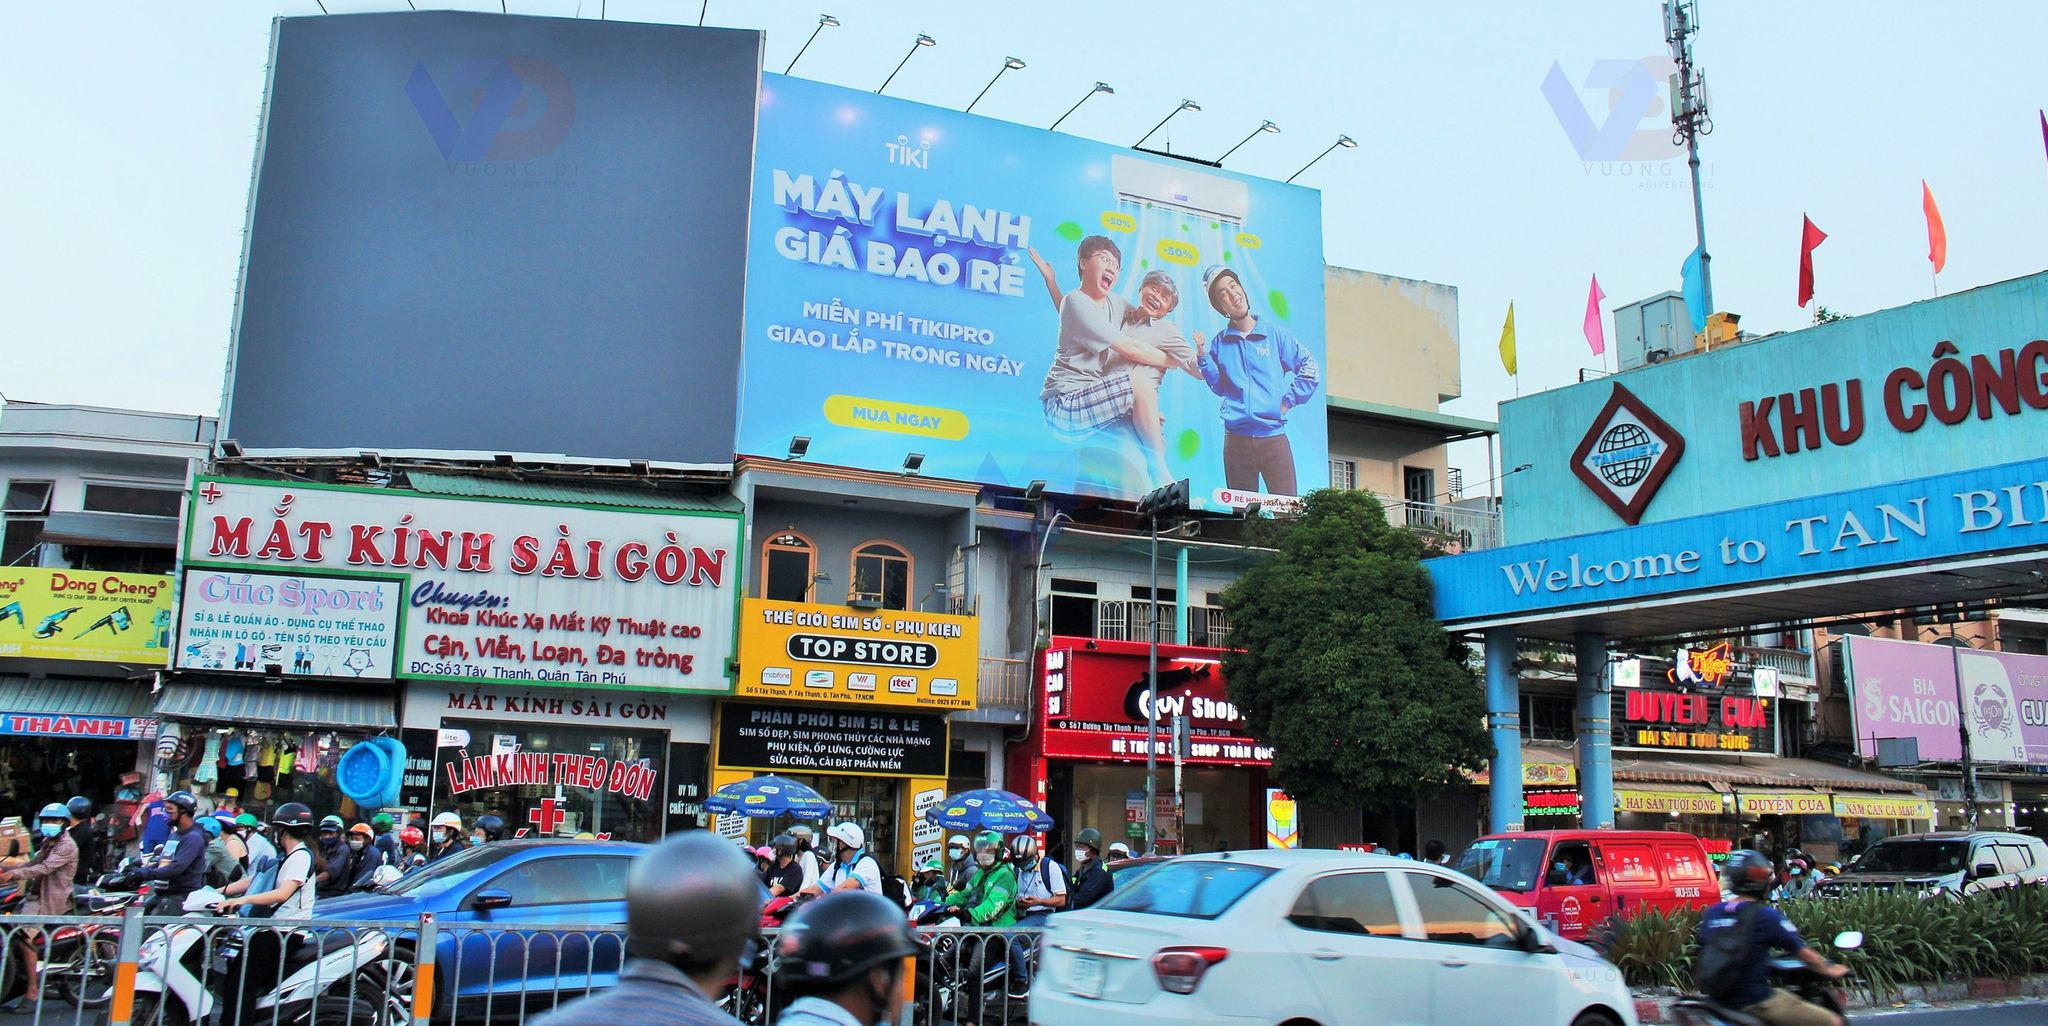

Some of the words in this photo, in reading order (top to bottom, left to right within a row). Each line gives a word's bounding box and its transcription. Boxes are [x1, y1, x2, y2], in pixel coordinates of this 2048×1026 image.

[772, 168, 884, 227] MÁY
[896, 192, 1031, 250] LẠNH
[774, 225, 860, 272] GIÁ
[866, 240, 961, 286] BAO
[965, 252, 1026, 297] RẺ
[1163, 246, 1194, 260] -50%
[802, 298, 861, 327] MIỄN
[866, 310, 904, 333] PHÍ
[908, 316, 995, 346] TIKIPRO
[766, 324, 826, 349] GIAO
[832, 328, 877, 354] LẮP
[882, 341, 961, 368] TRONG
[966, 349, 1025, 377] NGÀY
[1739, 377, 1865, 462] KHU
[1883, 340, 2048, 433] CÔNG
[852, 405, 890, 425] MUA
[895, 412, 943, 430] NGAY
[1591, 442, 1660, 467] TANIMEX
[208, 494, 333, 562] MẮT
[347, 512, 496, 573] KÍNH
[509, 523, 604, 580] SÀI
[614, 530, 727, 588] GÒN
[1500, 549, 1700, 597] Welcome
[1719, 535, 1767, 566] to
[1785, 496, 1929, 557] TAN
[51, 573, 97, 594] Dong
[102, 576, 158, 598] Cheng
[199, 575, 274, 605] Cúc
[278, 579, 384, 615] Sport
[411, 580, 510, 612] Chuyên:
[207, 614, 214, 622] &
[287, 617, 315, 630] DỤNG
[318, 619, 332, 631] CỤ
[358, 621, 385, 632] THAO
[426, 606, 469, 626] Khoa
[476, 610, 518, 629] Khúc
[524, 612, 545, 634] Xạ
[550, 611, 585, 632] Mắt
[591, 615, 611, 637] Kỹ
[617, 617, 666, 639] Thuật
[671, 623, 701, 639] cao
[831, 615, 859, 630] SIM
[862, 615, 883, 632] SỐ
[894, 620, 925, 637] PHỤ
[928, 621, 962, 640] KIỆN
[221, 629, 232, 639] IN
[314, 635, 341, 645] THEO
[423, 634, 470, 661] Cận,
[532, 640, 588, 666] Loạn,
[596, 644, 626, 666] Đa
[636, 646, 694, 675] tròng
[800, 638, 847, 658] TOP
[854, 641, 927, 664] STORE
[1046, 651, 1064, 670] BAO
[576, 670, 597, 683] Tân
[602, 671, 626, 685] Phú
[1691, 651, 1730, 682] Tiger
[1046, 673, 1064, 692] CAO
[1913, 678, 1936, 696] BIA
[447, 687, 498, 710] MẮT
[504, 691, 565, 715] KÍNH
[571, 694, 612, 717] SÀI
[620, 699, 667, 721] GÒN
[1048, 696, 1060, 715] SU
[1720, 695, 1766, 729] CUA
[11, 715, 124, 736] THÀNH
[838, 716, 865, 729] SIM
[887, 718, 898, 731] &
[739, 727, 756, 737] SIM
[758, 726, 771, 738] SỐ
[793, 730, 810, 740] SIM
[811, 731, 842, 742] PHONG
[868, 732, 884, 744] CÁC
[885, 733, 904, 745] NHÀ
[905, 736, 931, 747] MẠNG
[1112, 737, 1126, 755] HỆ
[1191, 743, 1220, 757] SHOP
[1223, 741, 1252, 758] TOÀN
[767, 741, 786, 752] PHỤ
[888, 748, 905, 759] LỰC
[819, 756, 834, 767] CÀI
[2013, 746, 2024, 759] 15
[416, 757, 432, 771] KÍNH
[446, 751, 493, 794] LÀM
[497, 744, 549, 786] KÍNH
[553, 753, 607, 789] THEO
[609, 759, 657, 800] ĐƠN
[415, 773, 429, 787] GÒN
[678, 784, 687, 797] UY
[1748, 796, 1793, 811] DUYÊN
[1798, 799, 1825, 812] CUA
[1899, 805, 1914, 816] MAU
